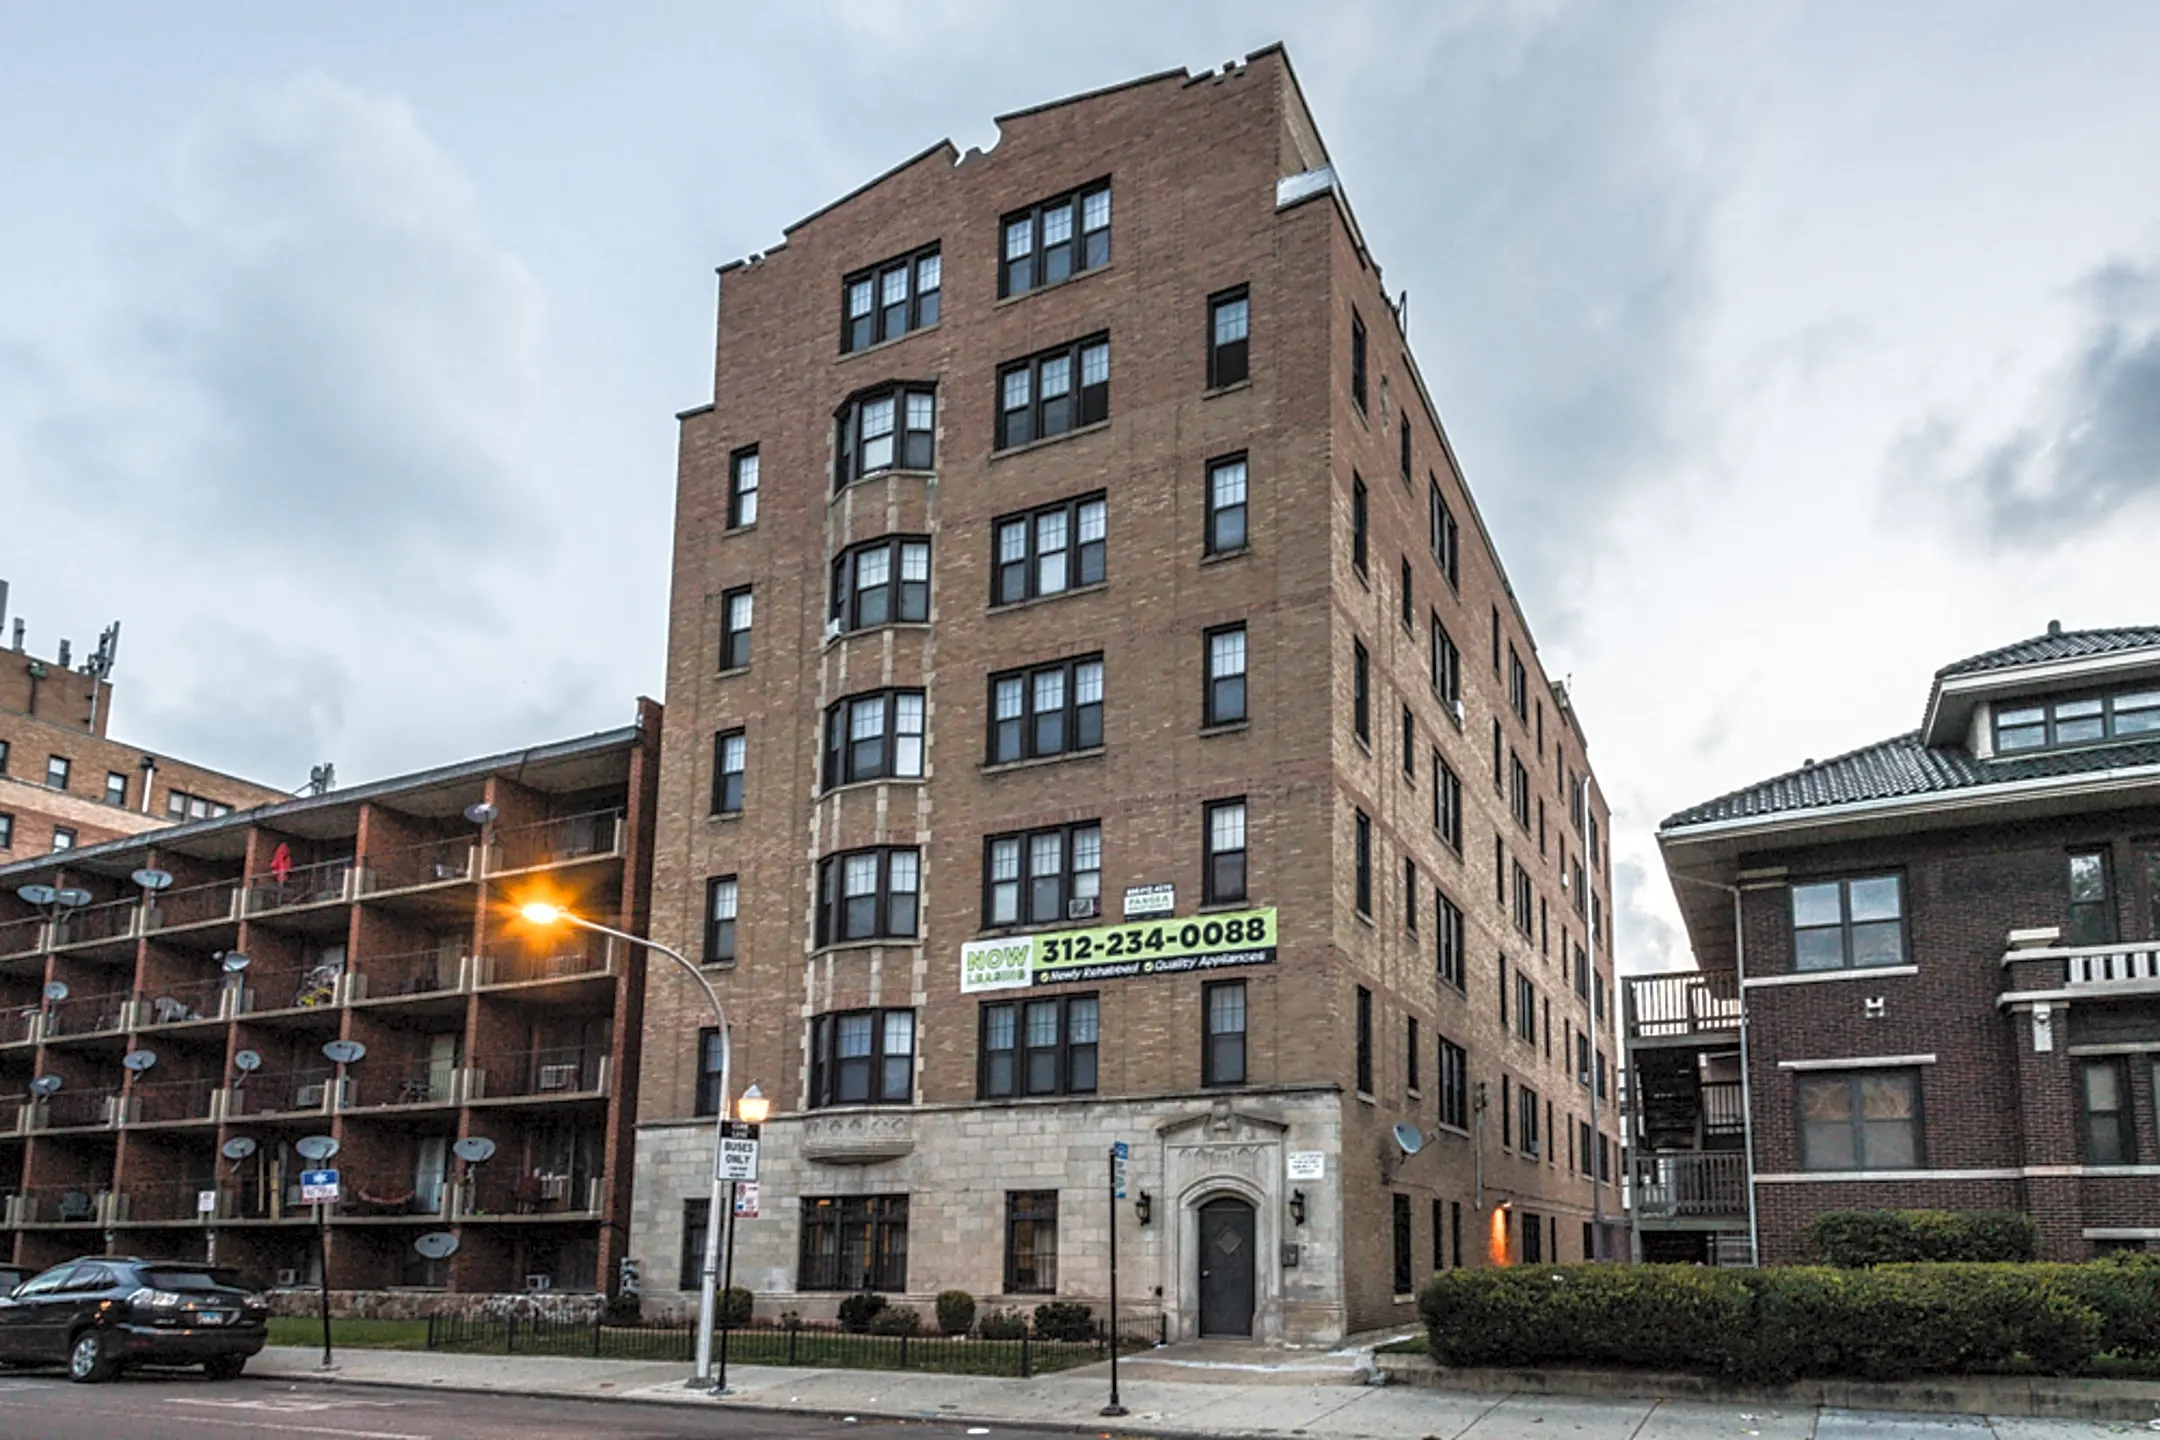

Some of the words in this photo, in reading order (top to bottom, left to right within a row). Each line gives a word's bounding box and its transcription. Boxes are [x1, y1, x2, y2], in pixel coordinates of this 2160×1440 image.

[1042, 917, 1266, 963] 312-234-0088
[967, 944, 1030, 971] NOW
[1155, 957, 1196, 972] Quality
[1051, 968, 1081, 981] Newly
[725, 1141, 753, 1153] BUSES
[725, 1154, 750, 1164] ONLY
